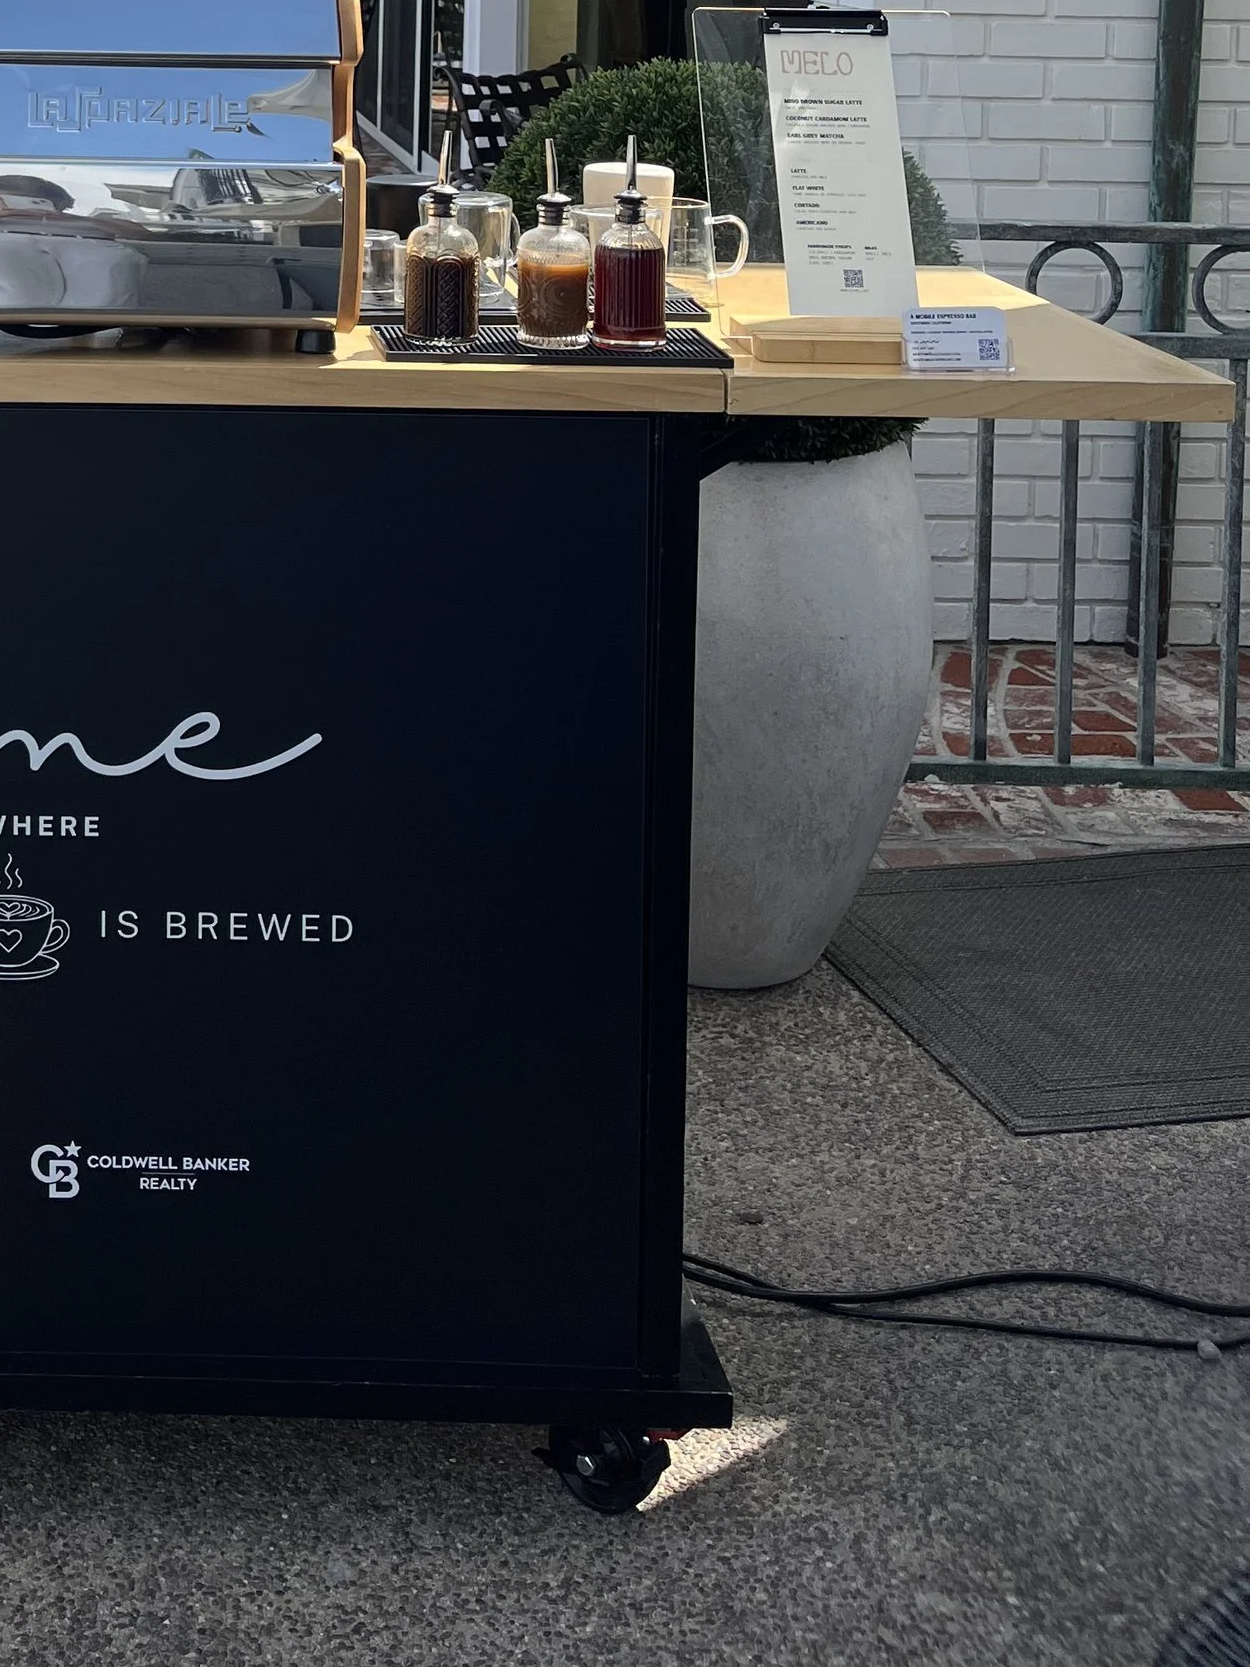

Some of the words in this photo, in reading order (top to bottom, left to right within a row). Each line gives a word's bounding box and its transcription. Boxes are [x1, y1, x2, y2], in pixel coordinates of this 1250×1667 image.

[780, 49, 853, 75] MELO
[101, 910, 139, 939] IS
[166, 911, 353, 943] BREWED
[86, 1155, 178, 1171] COLDWELL
[182, 1157, 251, 1173] BANKER
[139, 1177, 198, 1191] REALTY
